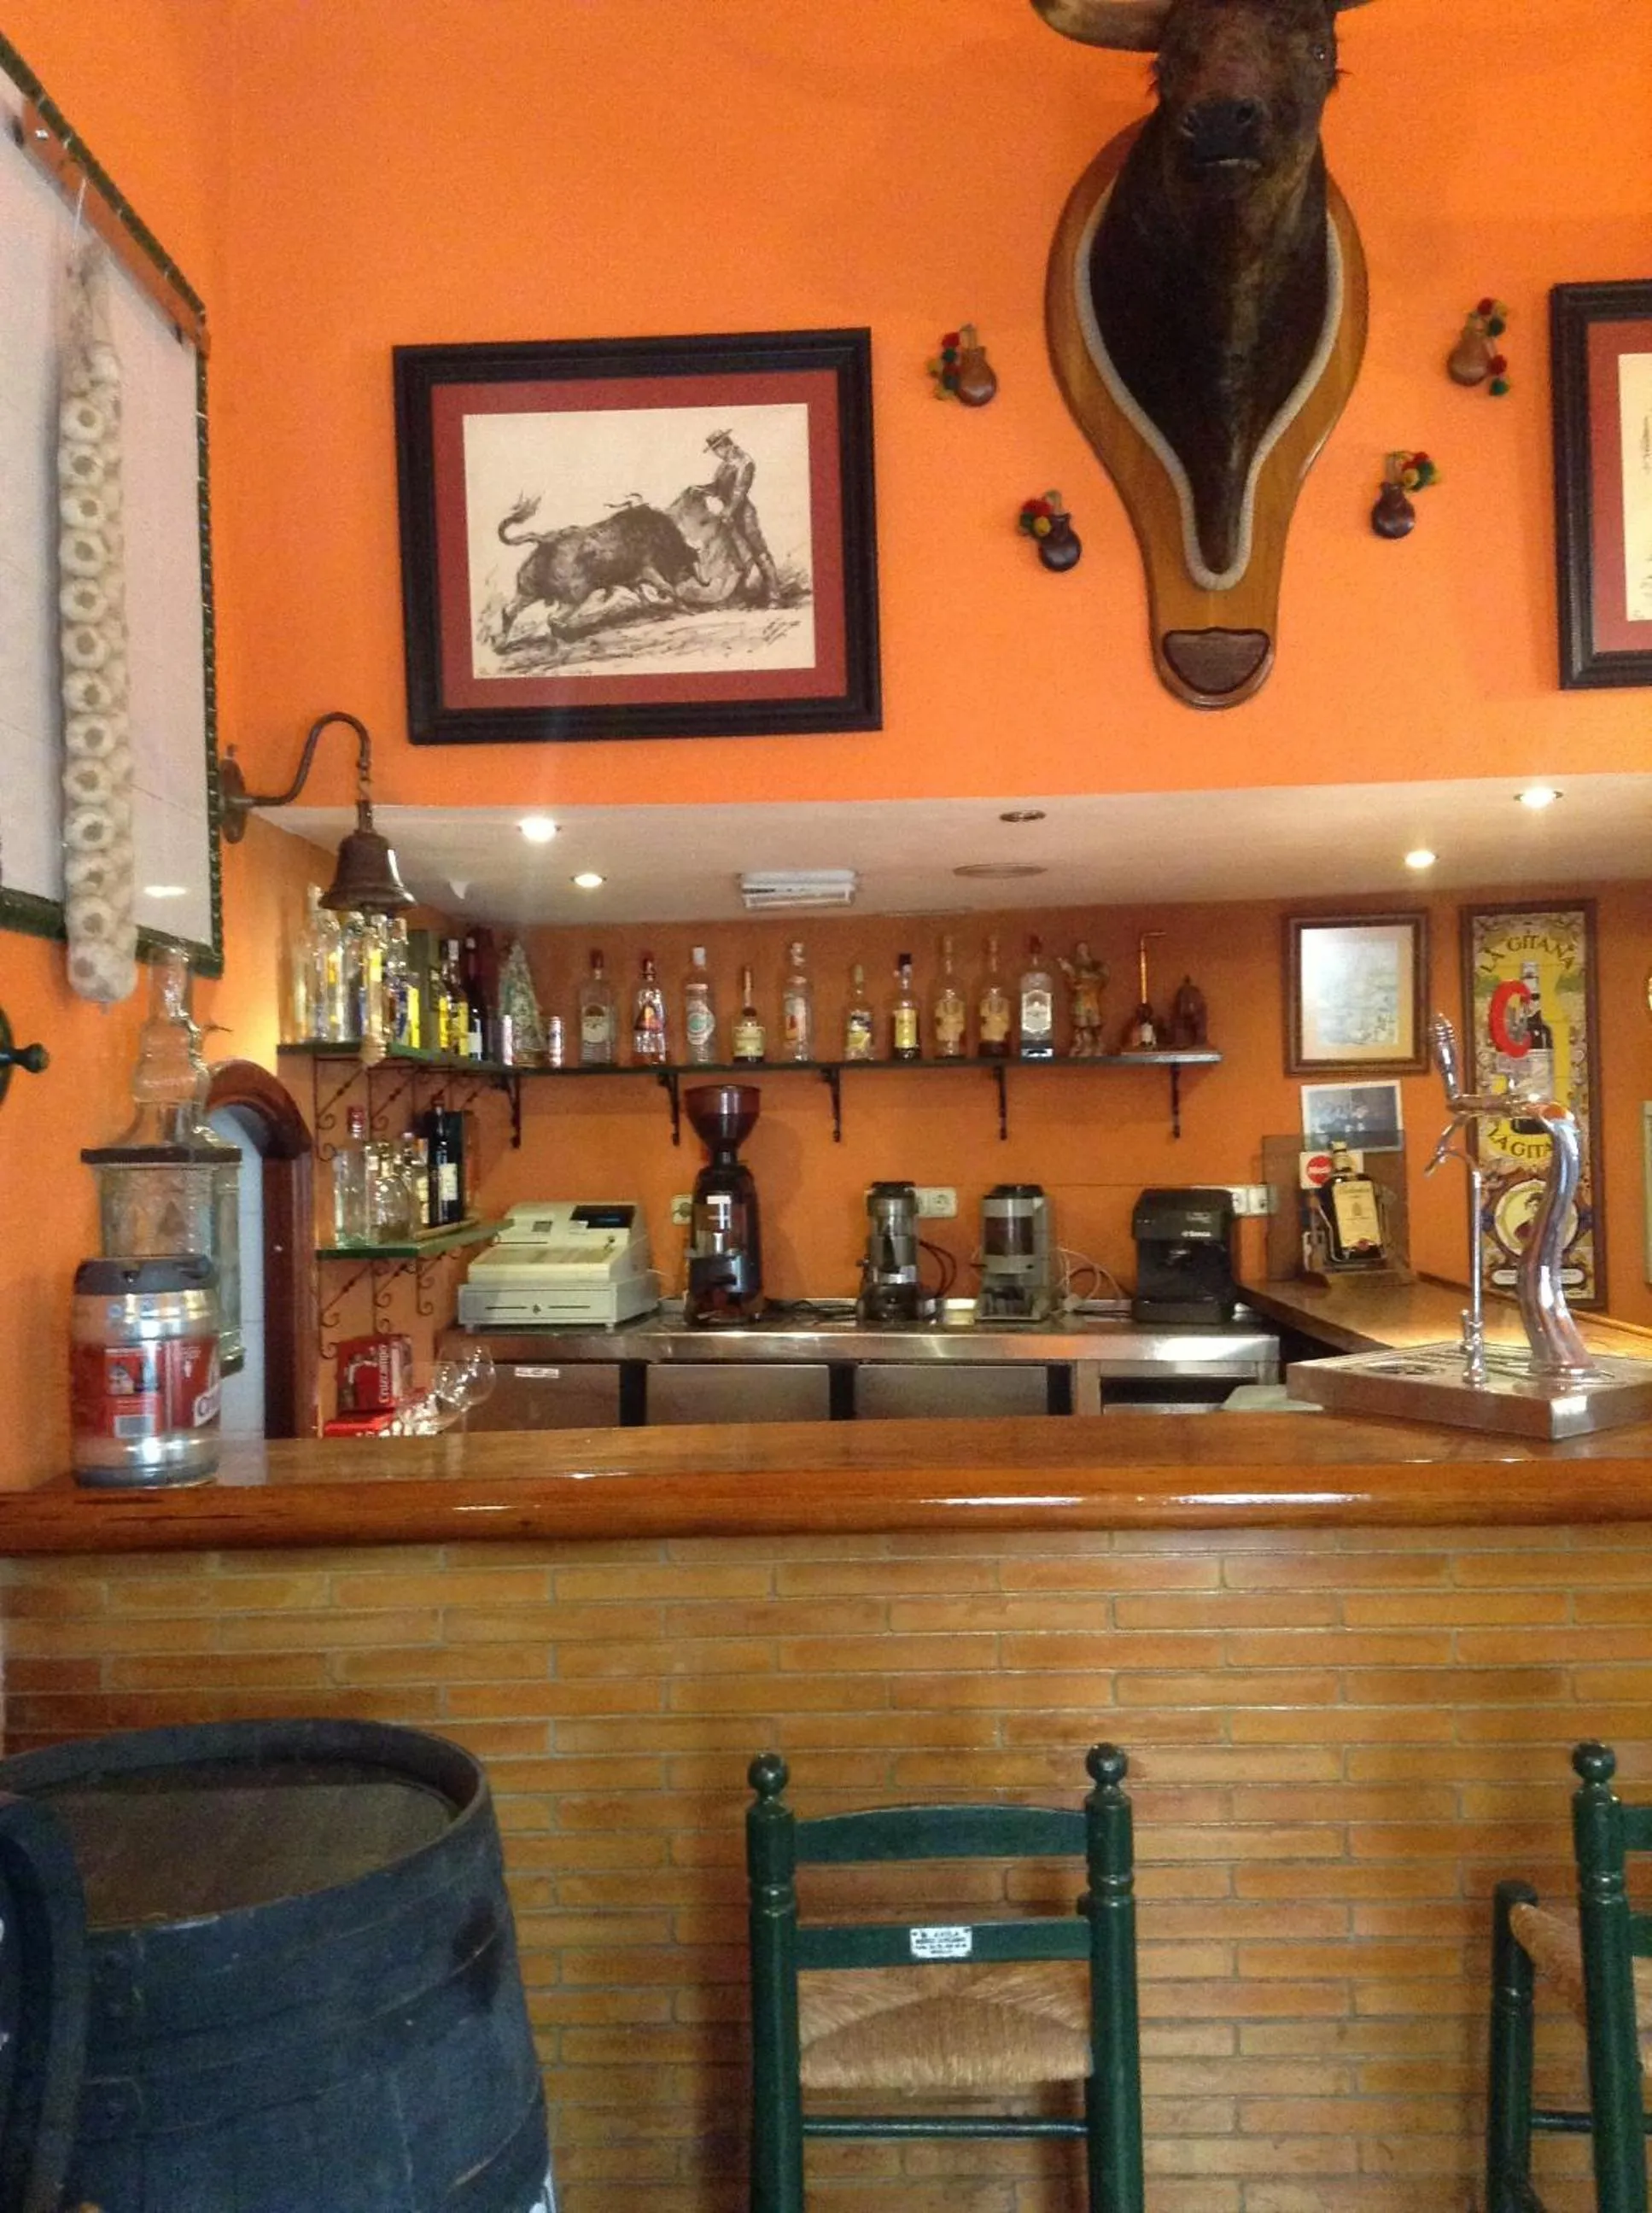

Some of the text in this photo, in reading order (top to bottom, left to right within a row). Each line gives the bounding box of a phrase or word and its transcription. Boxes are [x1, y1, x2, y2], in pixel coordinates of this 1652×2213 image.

[1480, 929, 1576, 972] LA GITANA
[1488, 1120, 1553, 1159] LA GITA
